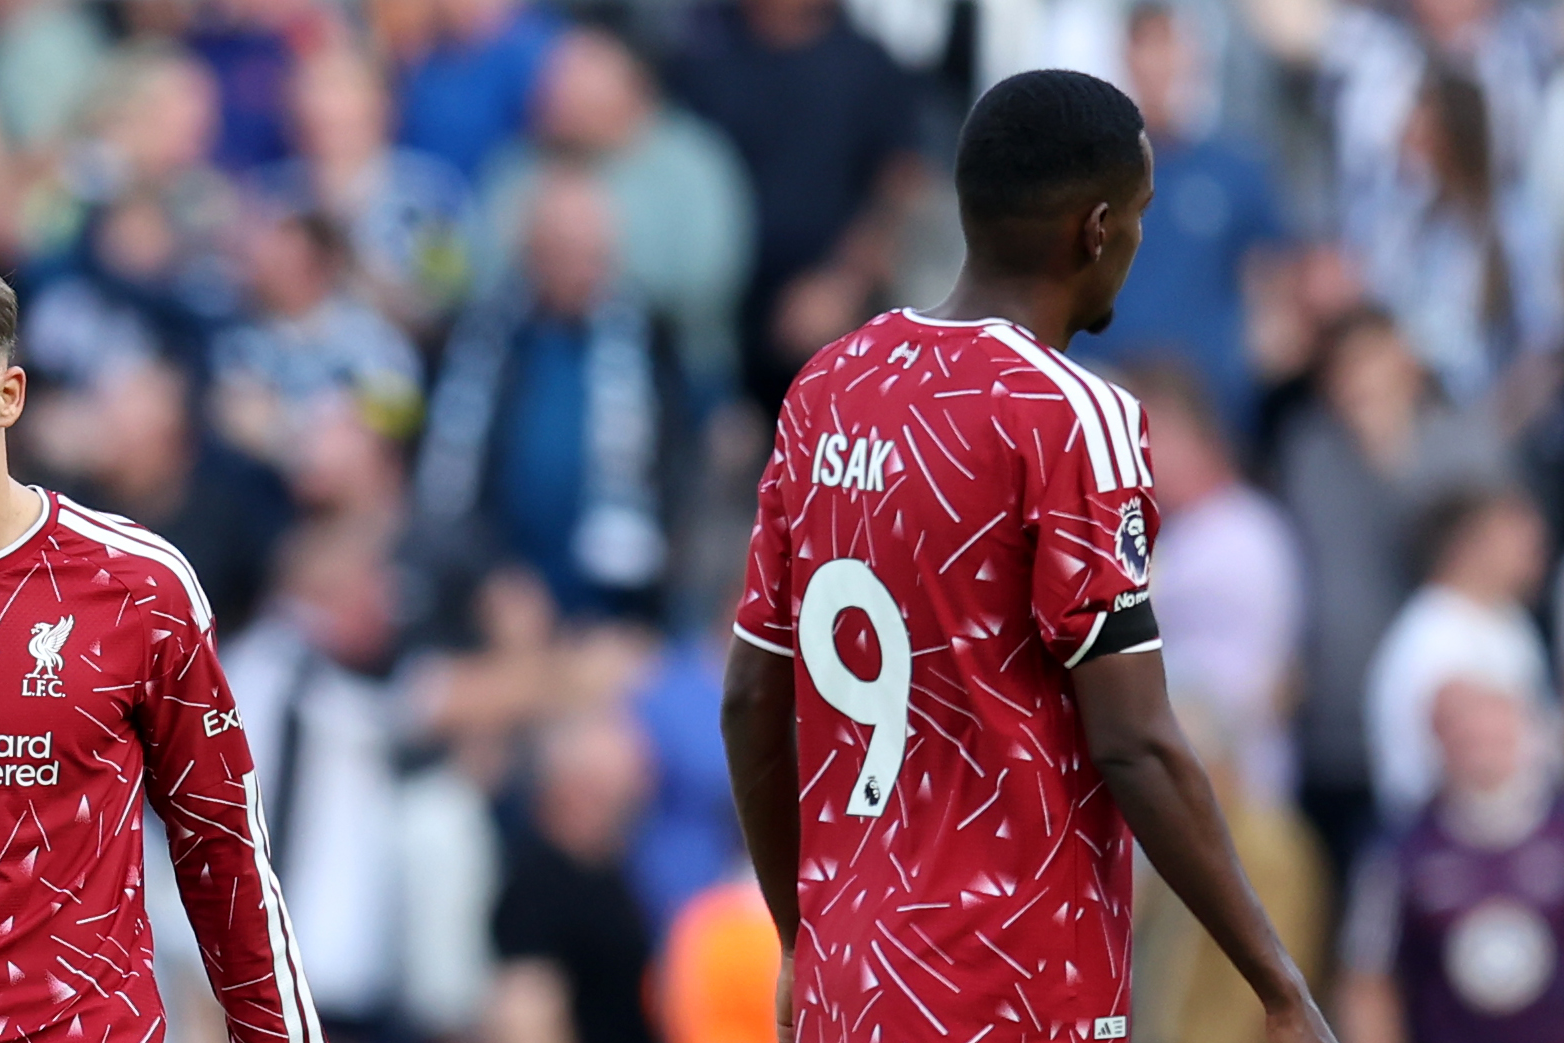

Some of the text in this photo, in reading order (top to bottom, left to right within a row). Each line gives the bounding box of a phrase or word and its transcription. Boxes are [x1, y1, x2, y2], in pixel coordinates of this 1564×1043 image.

[811, 432, 895, 492] ISAK
[798, 558, 912, 817] 9
[203, 706, 243, 738] Ex
